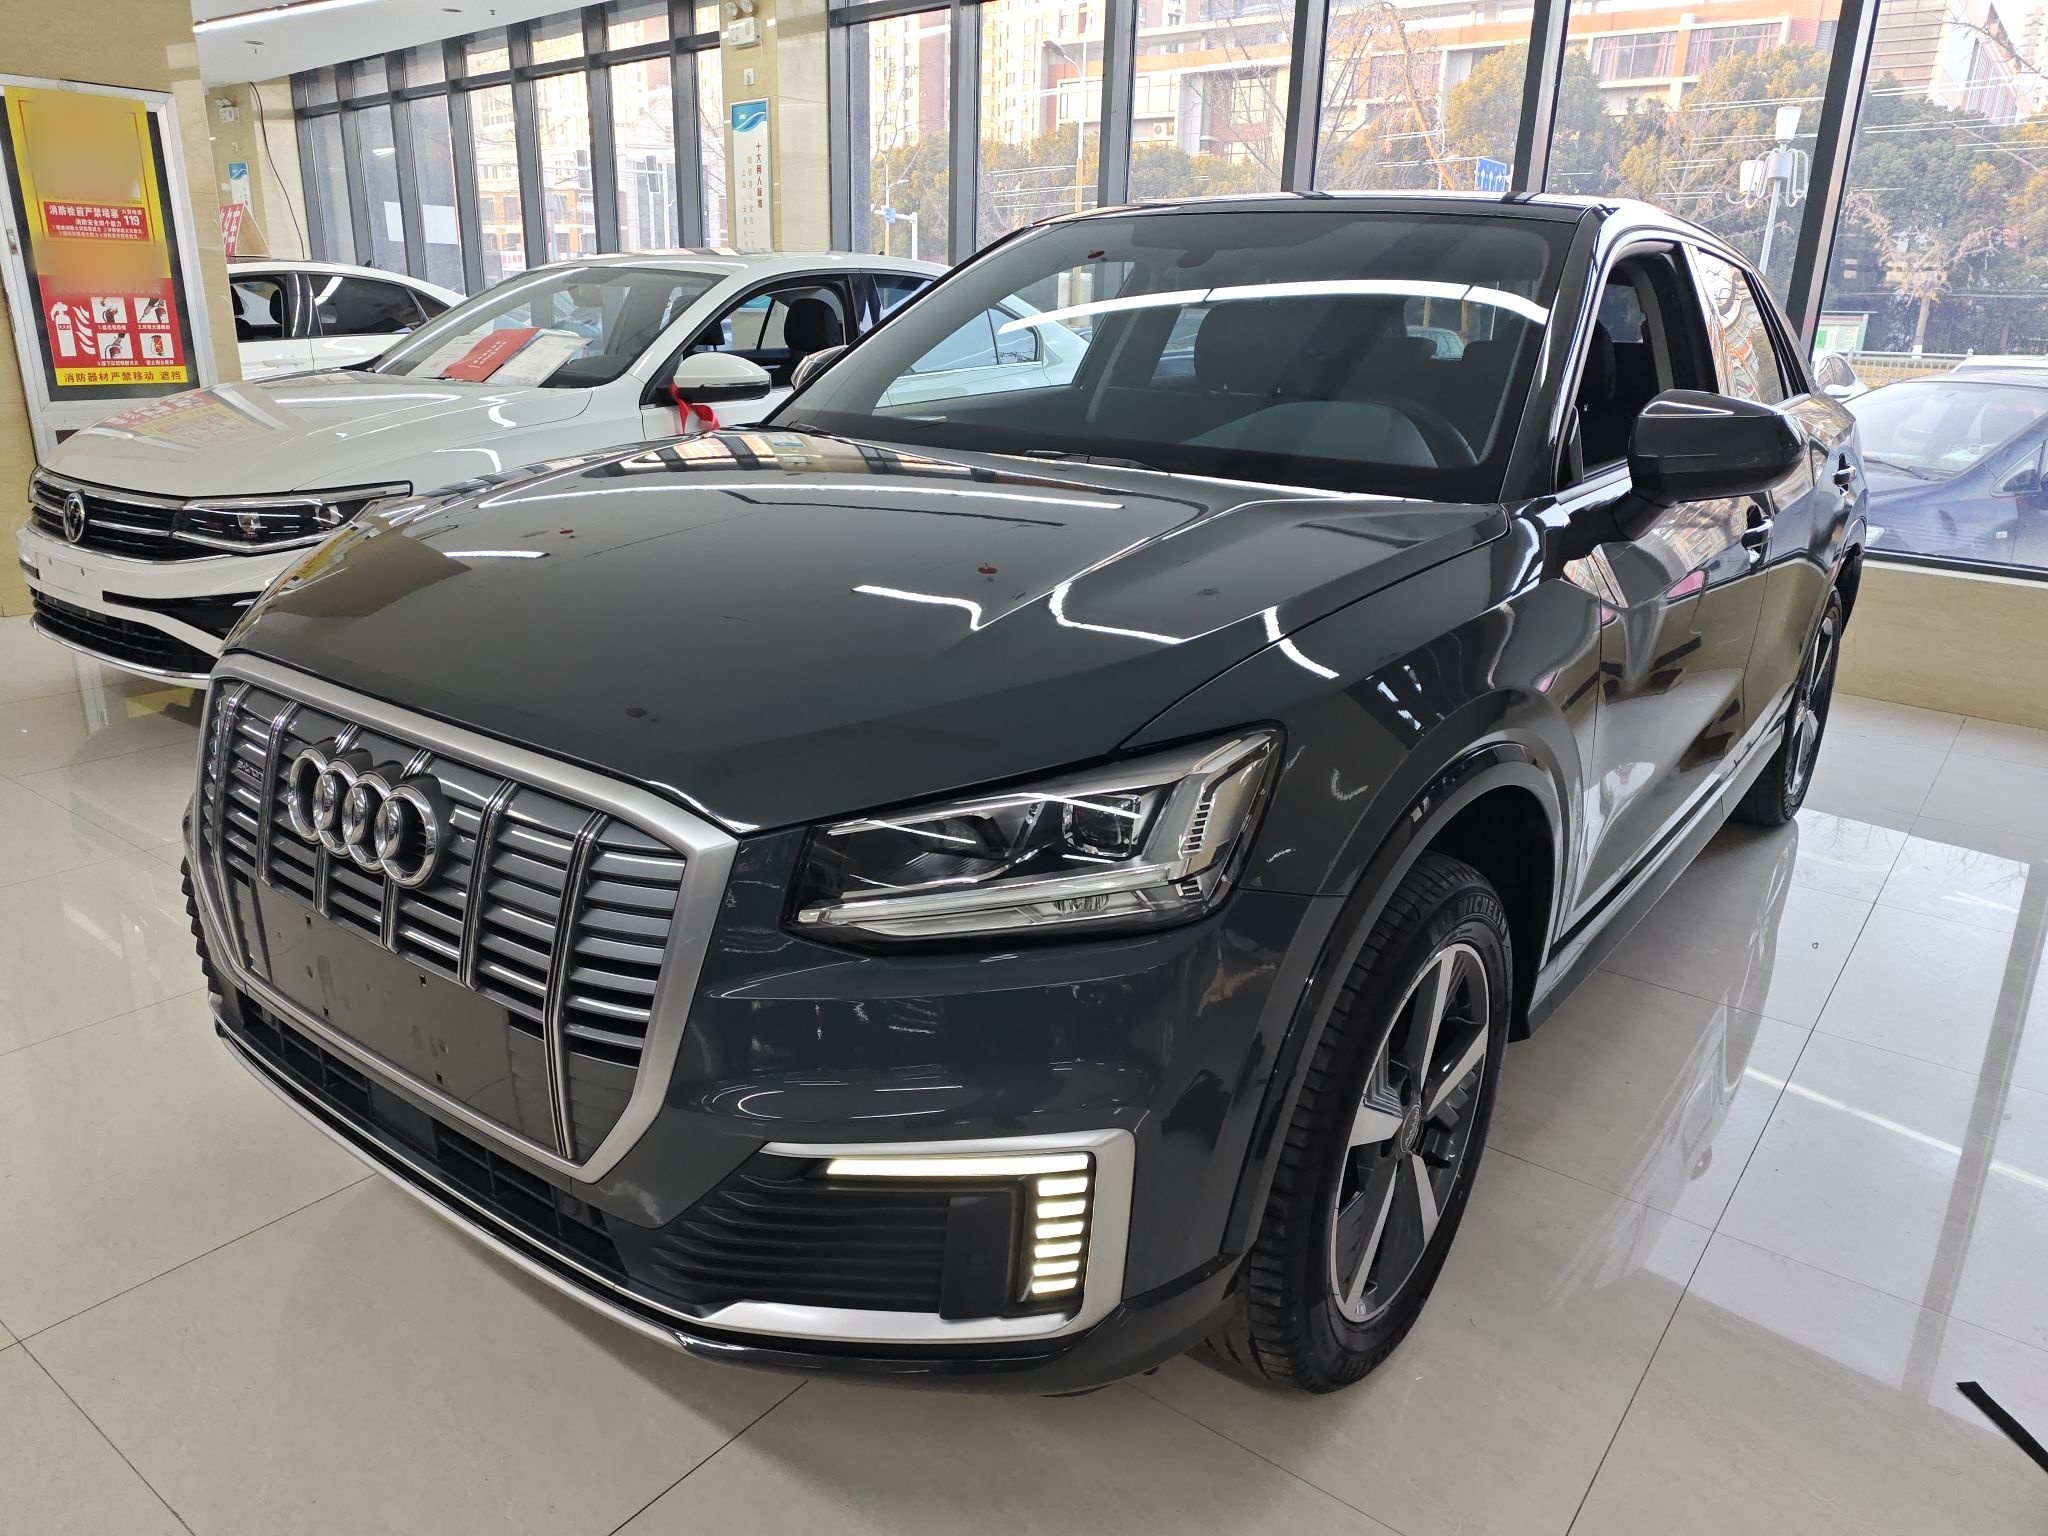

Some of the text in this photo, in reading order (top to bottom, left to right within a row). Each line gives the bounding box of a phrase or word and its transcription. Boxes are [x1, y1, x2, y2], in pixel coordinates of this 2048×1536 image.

[123, 215, 140, 226] 119
[64, 370, 154, 383] 消防器材严禁移动
